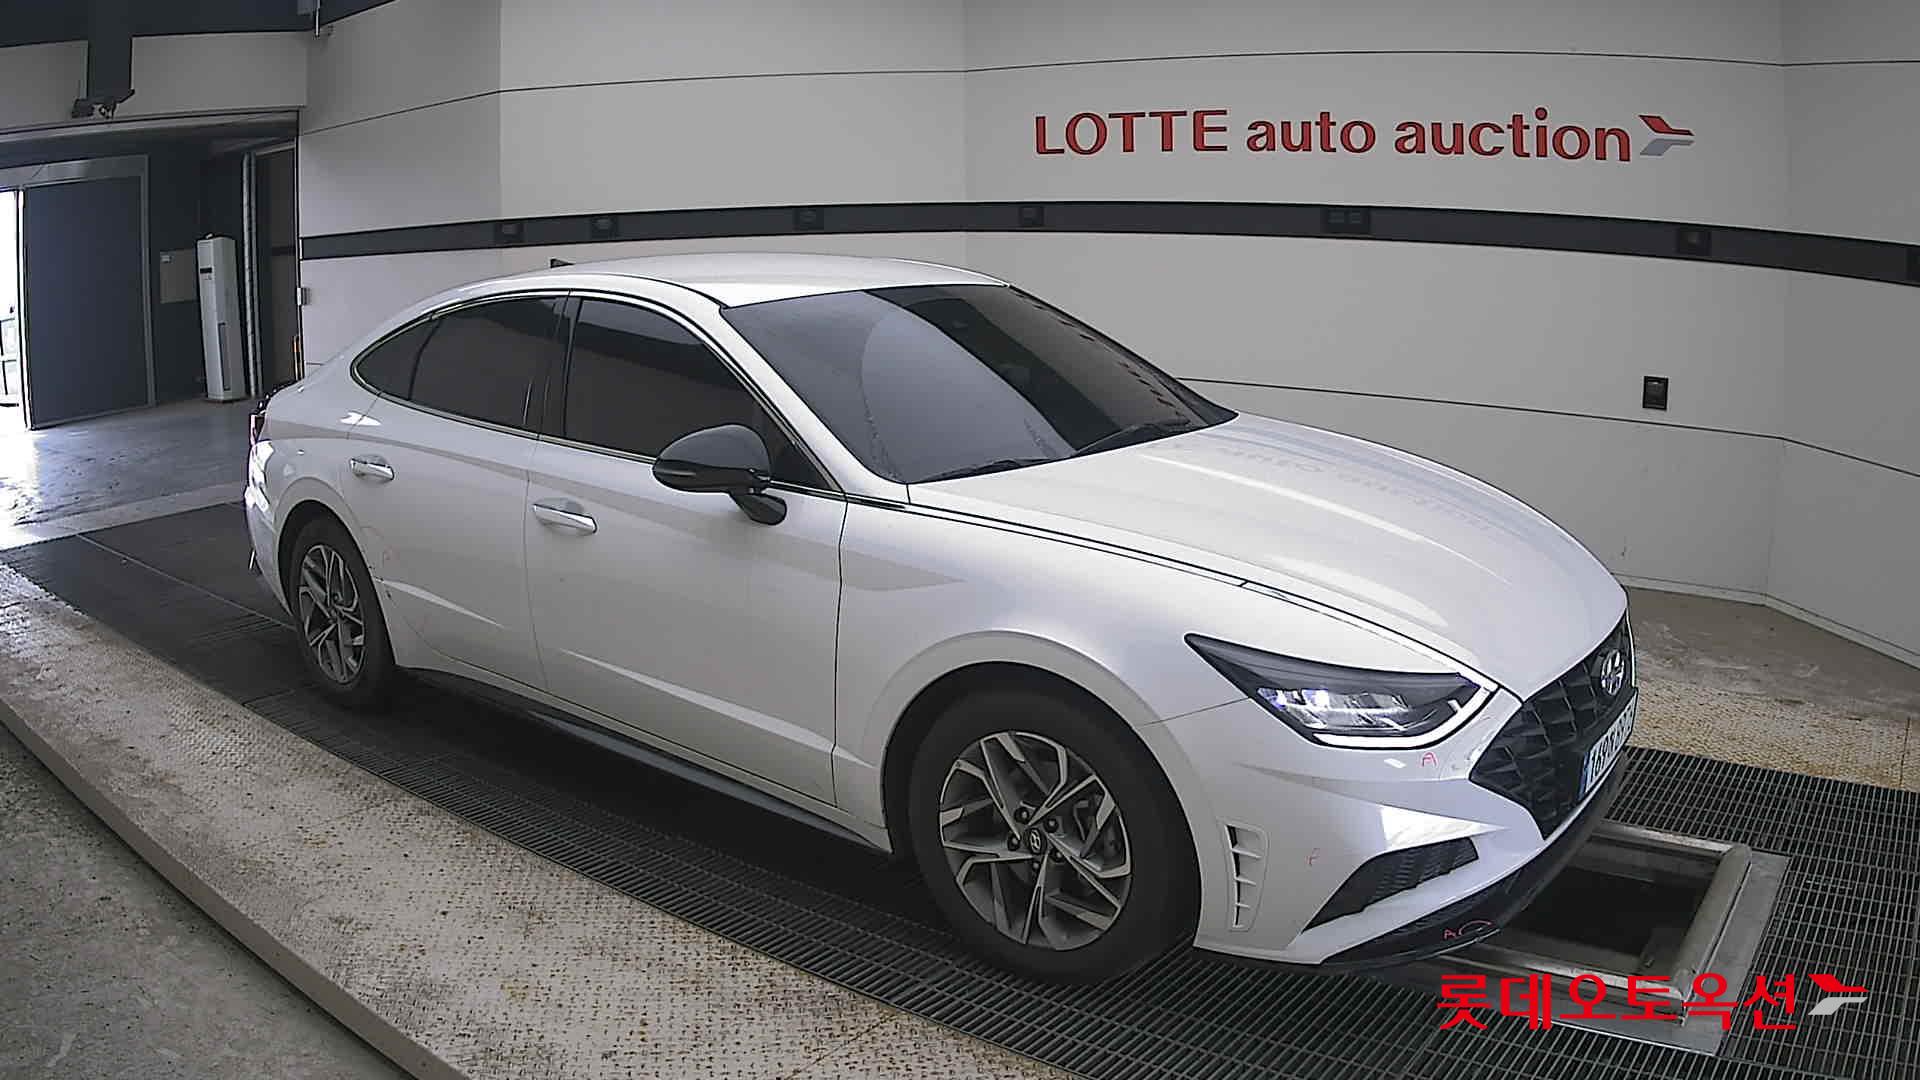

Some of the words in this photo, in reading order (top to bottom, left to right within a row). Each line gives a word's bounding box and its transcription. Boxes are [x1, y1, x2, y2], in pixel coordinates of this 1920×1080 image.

[1035, 109, 1228, 155] LOTTE
[1246, 111, 1376, 154] auto
[1394, 106, 1631, 162] auction
